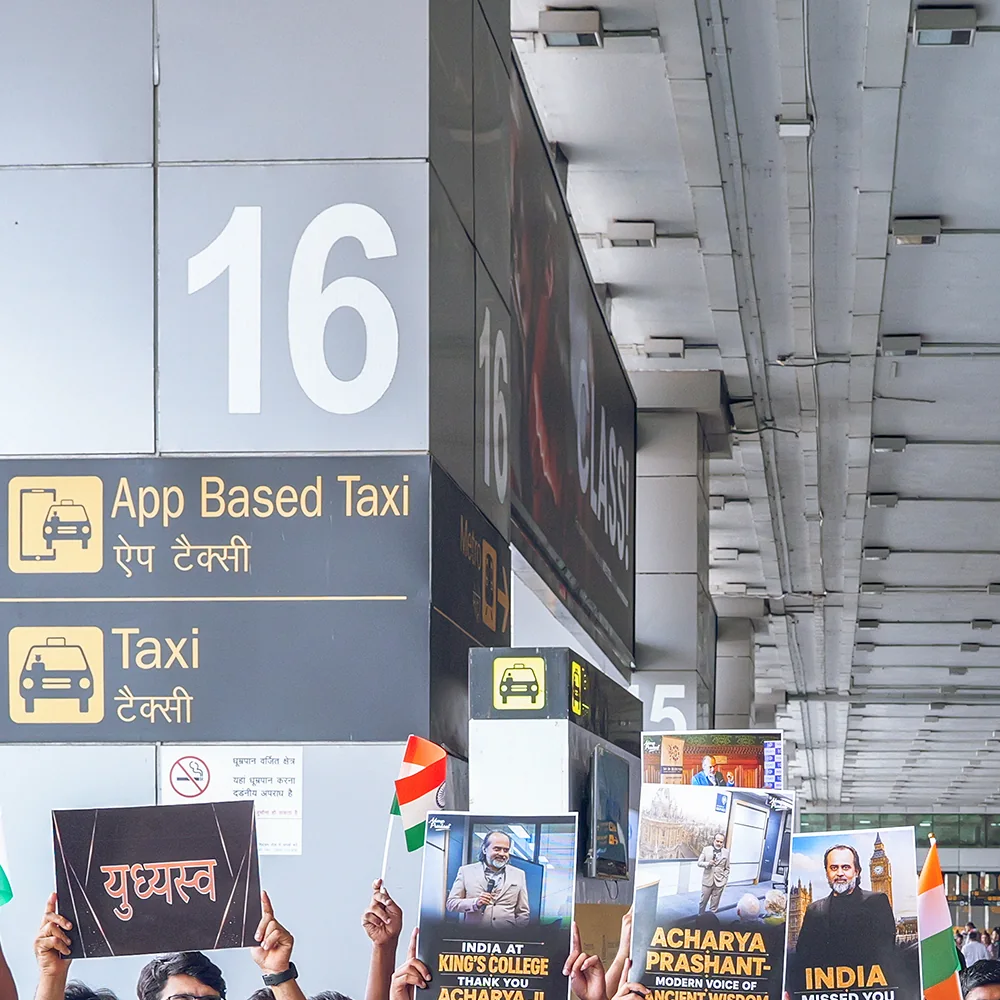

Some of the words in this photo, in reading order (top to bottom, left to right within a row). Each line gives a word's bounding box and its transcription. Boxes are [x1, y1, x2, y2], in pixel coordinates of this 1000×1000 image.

[187, 202, 399, 415] 16
[479, 306, 509, 504] 16
[111, 477, 185, 527] App
[200, 476, 322, 518] Based
[337, 475, 410, 517] Taxi
[113, 534, 155, 577] ऐप
[171, 534, 251, 572] टैक्सी
[111, 627, 199, 669] Taxi
[114, 686, 193, 724] टैक्सी
[629, 684, 687, 731] 5
[100, 859, 217, 921] युध्यस्व
[461, 942, 502, 954] INDIA
[505, 944, 525, 955] AT
[650, 926, 766, 953] ACHARYA
[438, 953, 487, 973] KING'S
[488, 955, 549, 976] COLLEGE
[457, 976, 500, 988] THANK
[502, 978, 529, 988] YOU
[645, 950, 771, 976] PRASHANT-
[805, 964, 887, 990] INDIA
[655, 976, 703, 988] MODERN
[706, 978, 739, 990] VOICE
[741, 980, 758, 991] OF
